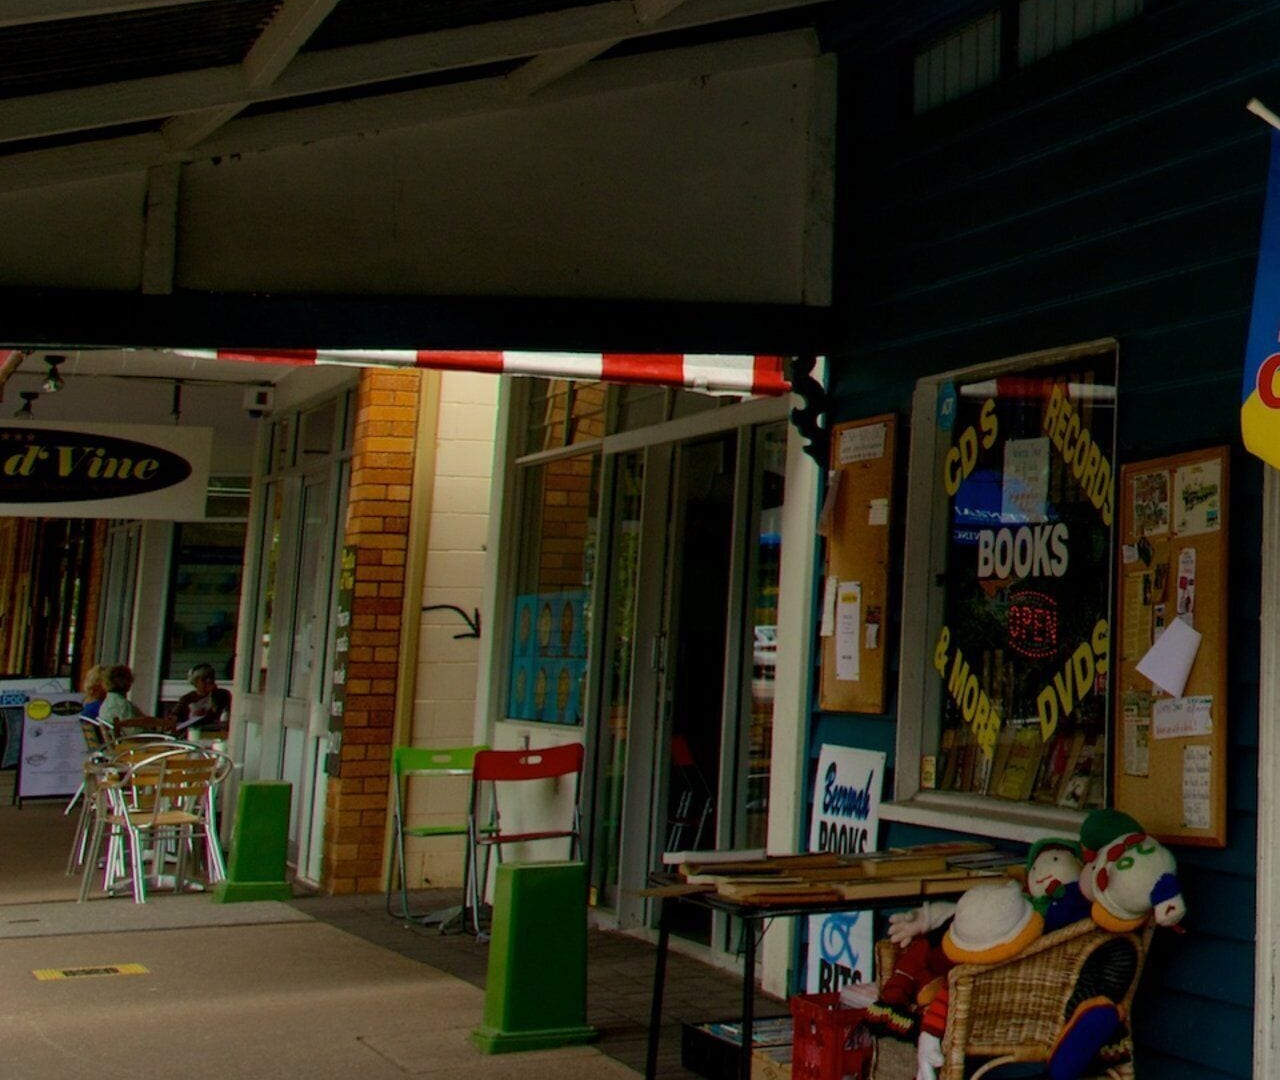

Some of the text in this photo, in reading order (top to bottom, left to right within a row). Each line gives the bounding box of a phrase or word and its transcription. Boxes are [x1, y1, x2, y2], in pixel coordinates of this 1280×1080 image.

[1043, 382, 1115, 528] RECORDS
[976, 522, 1070, 580] BOOKS
[1007, 603, 1058, 644] OPEN
[1036, 618, 1110, 744] DVDS
[933, 625, 1003, 760] & MORE
